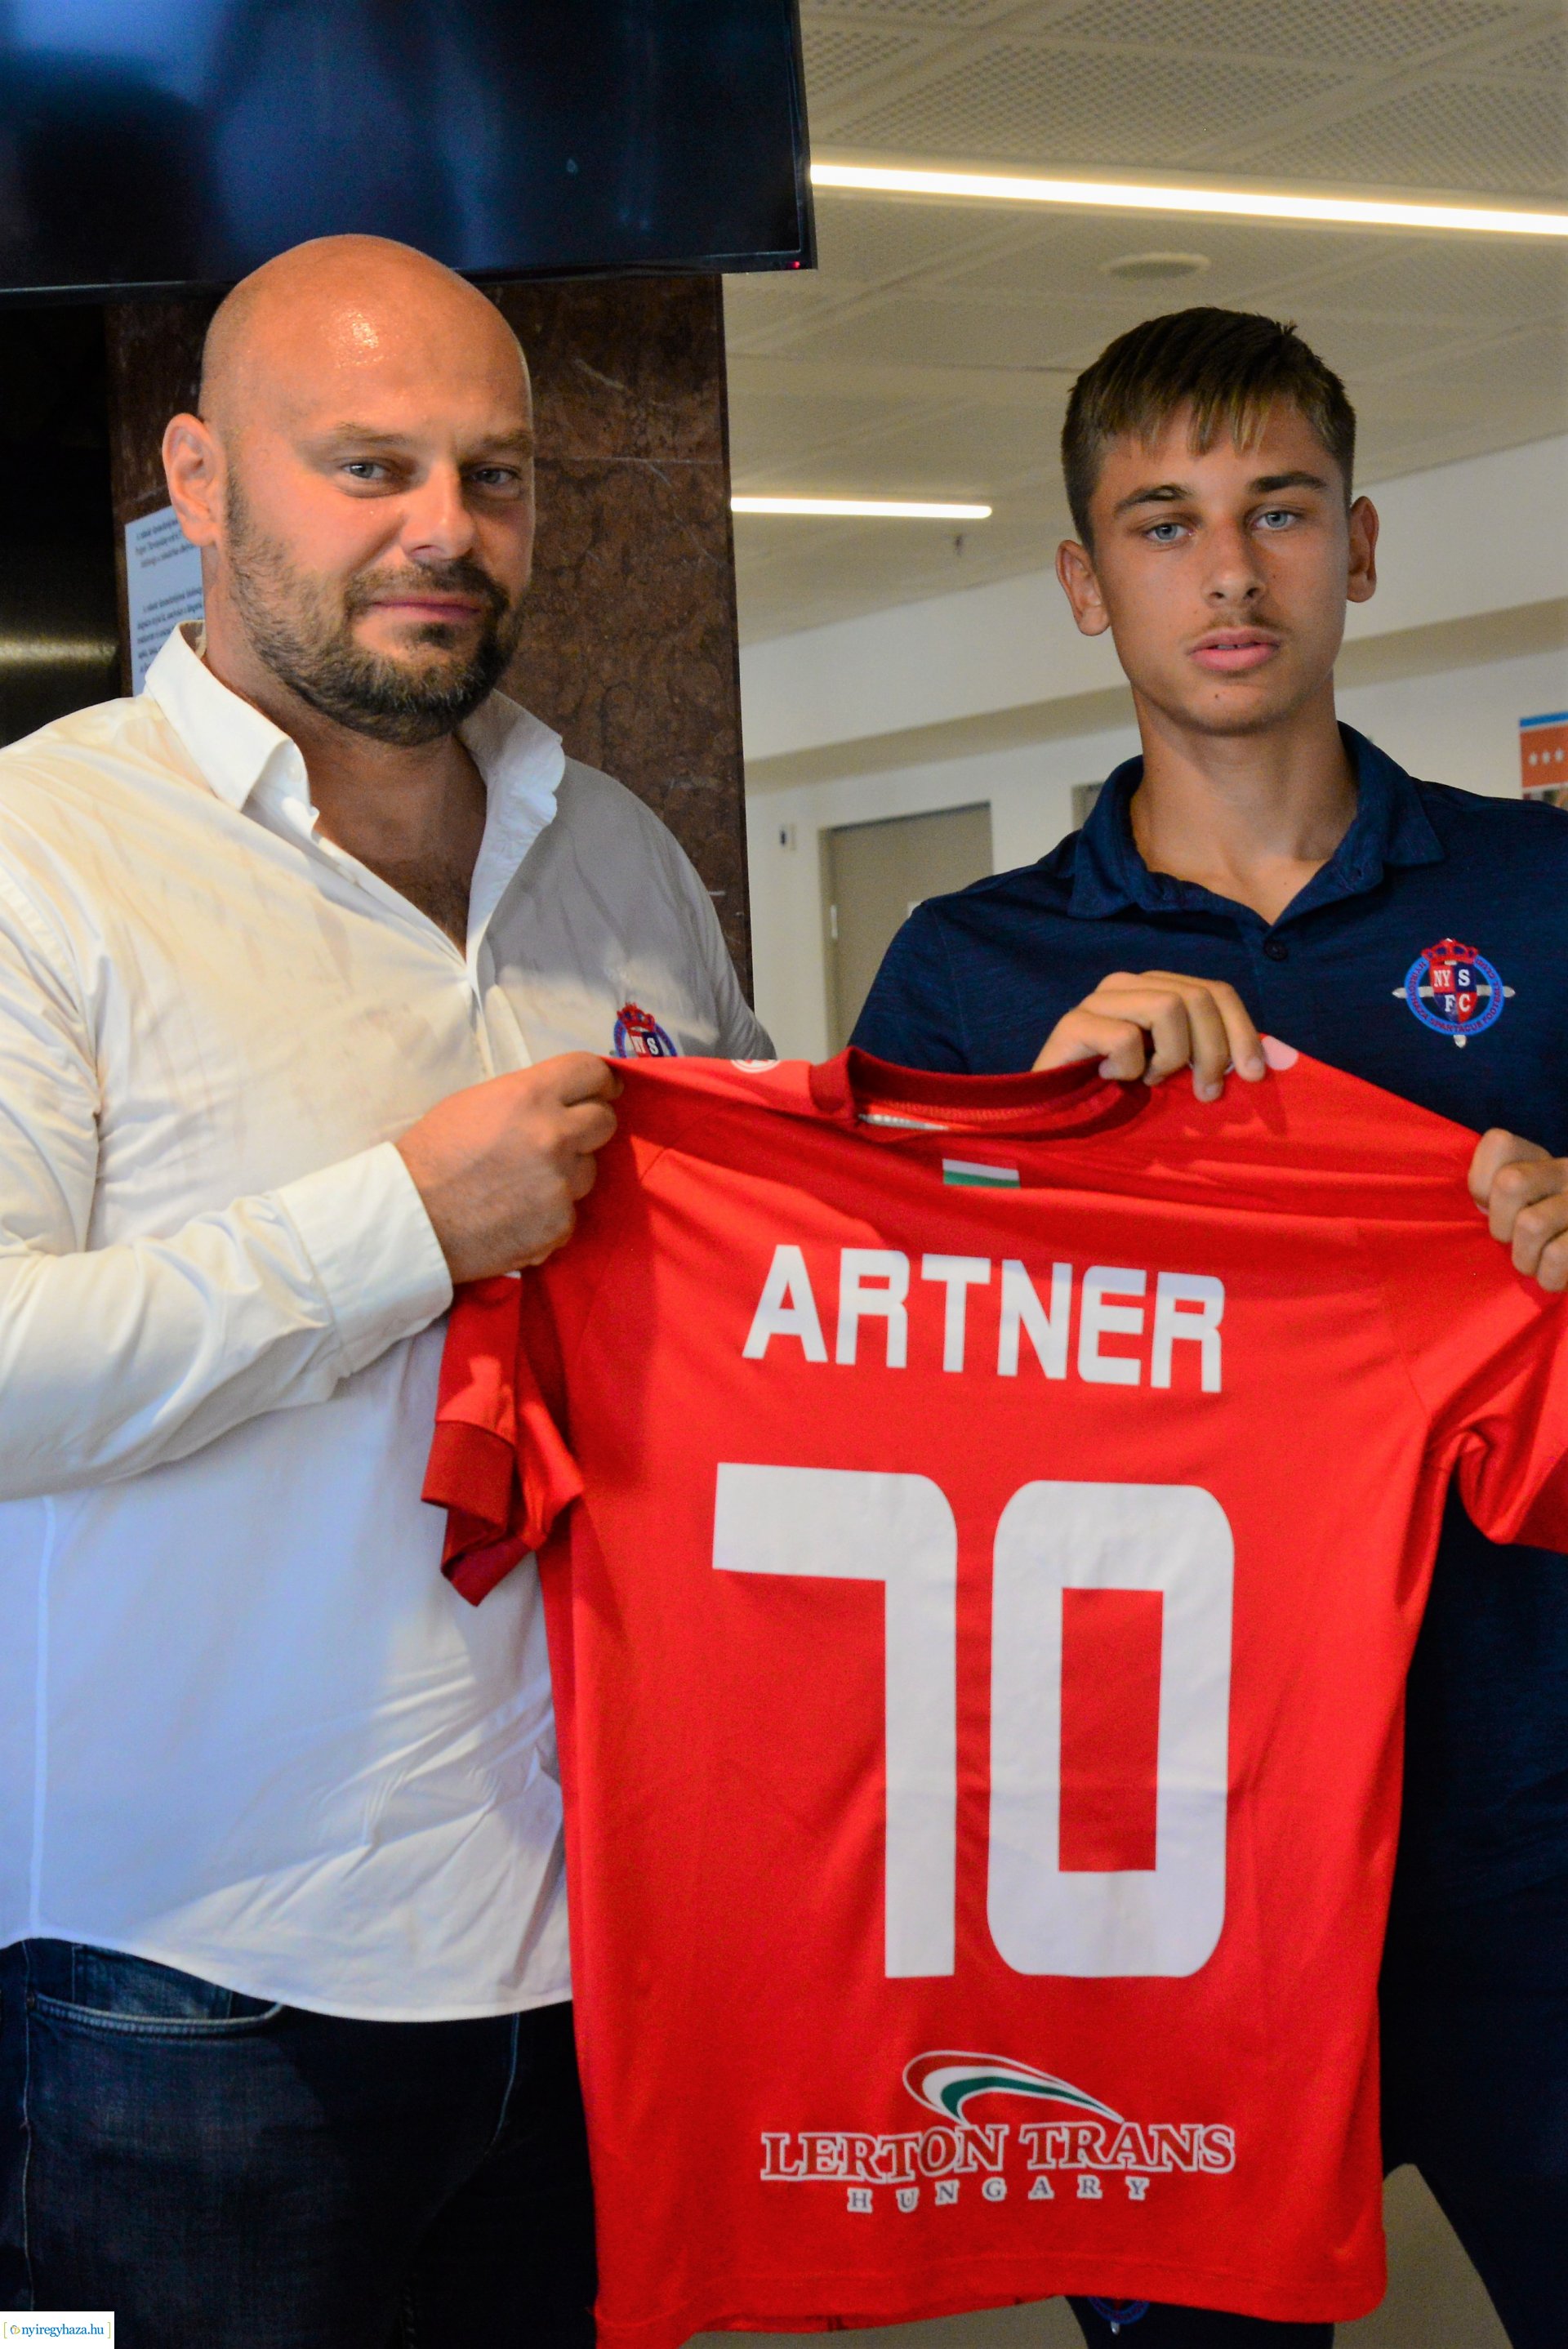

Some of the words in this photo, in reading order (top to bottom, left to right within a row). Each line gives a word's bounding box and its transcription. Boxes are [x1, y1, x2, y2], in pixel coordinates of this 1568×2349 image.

[1433, 969, 1451, 987] NY
[1458, 969, 1471, 987] S
[1445, 994, 1455, 1012] F
[1459, 993, 1471, 1012] C
[742, 1244, 1225, 1393] ARTNER
[712, 1462, 1235, 1977] 70
[760, 2124, 1009, 2184] LERTON
[1019, 2121, 1236, 2173] TRANS
[847, 2175, 1150, 2213] HUNGARY
